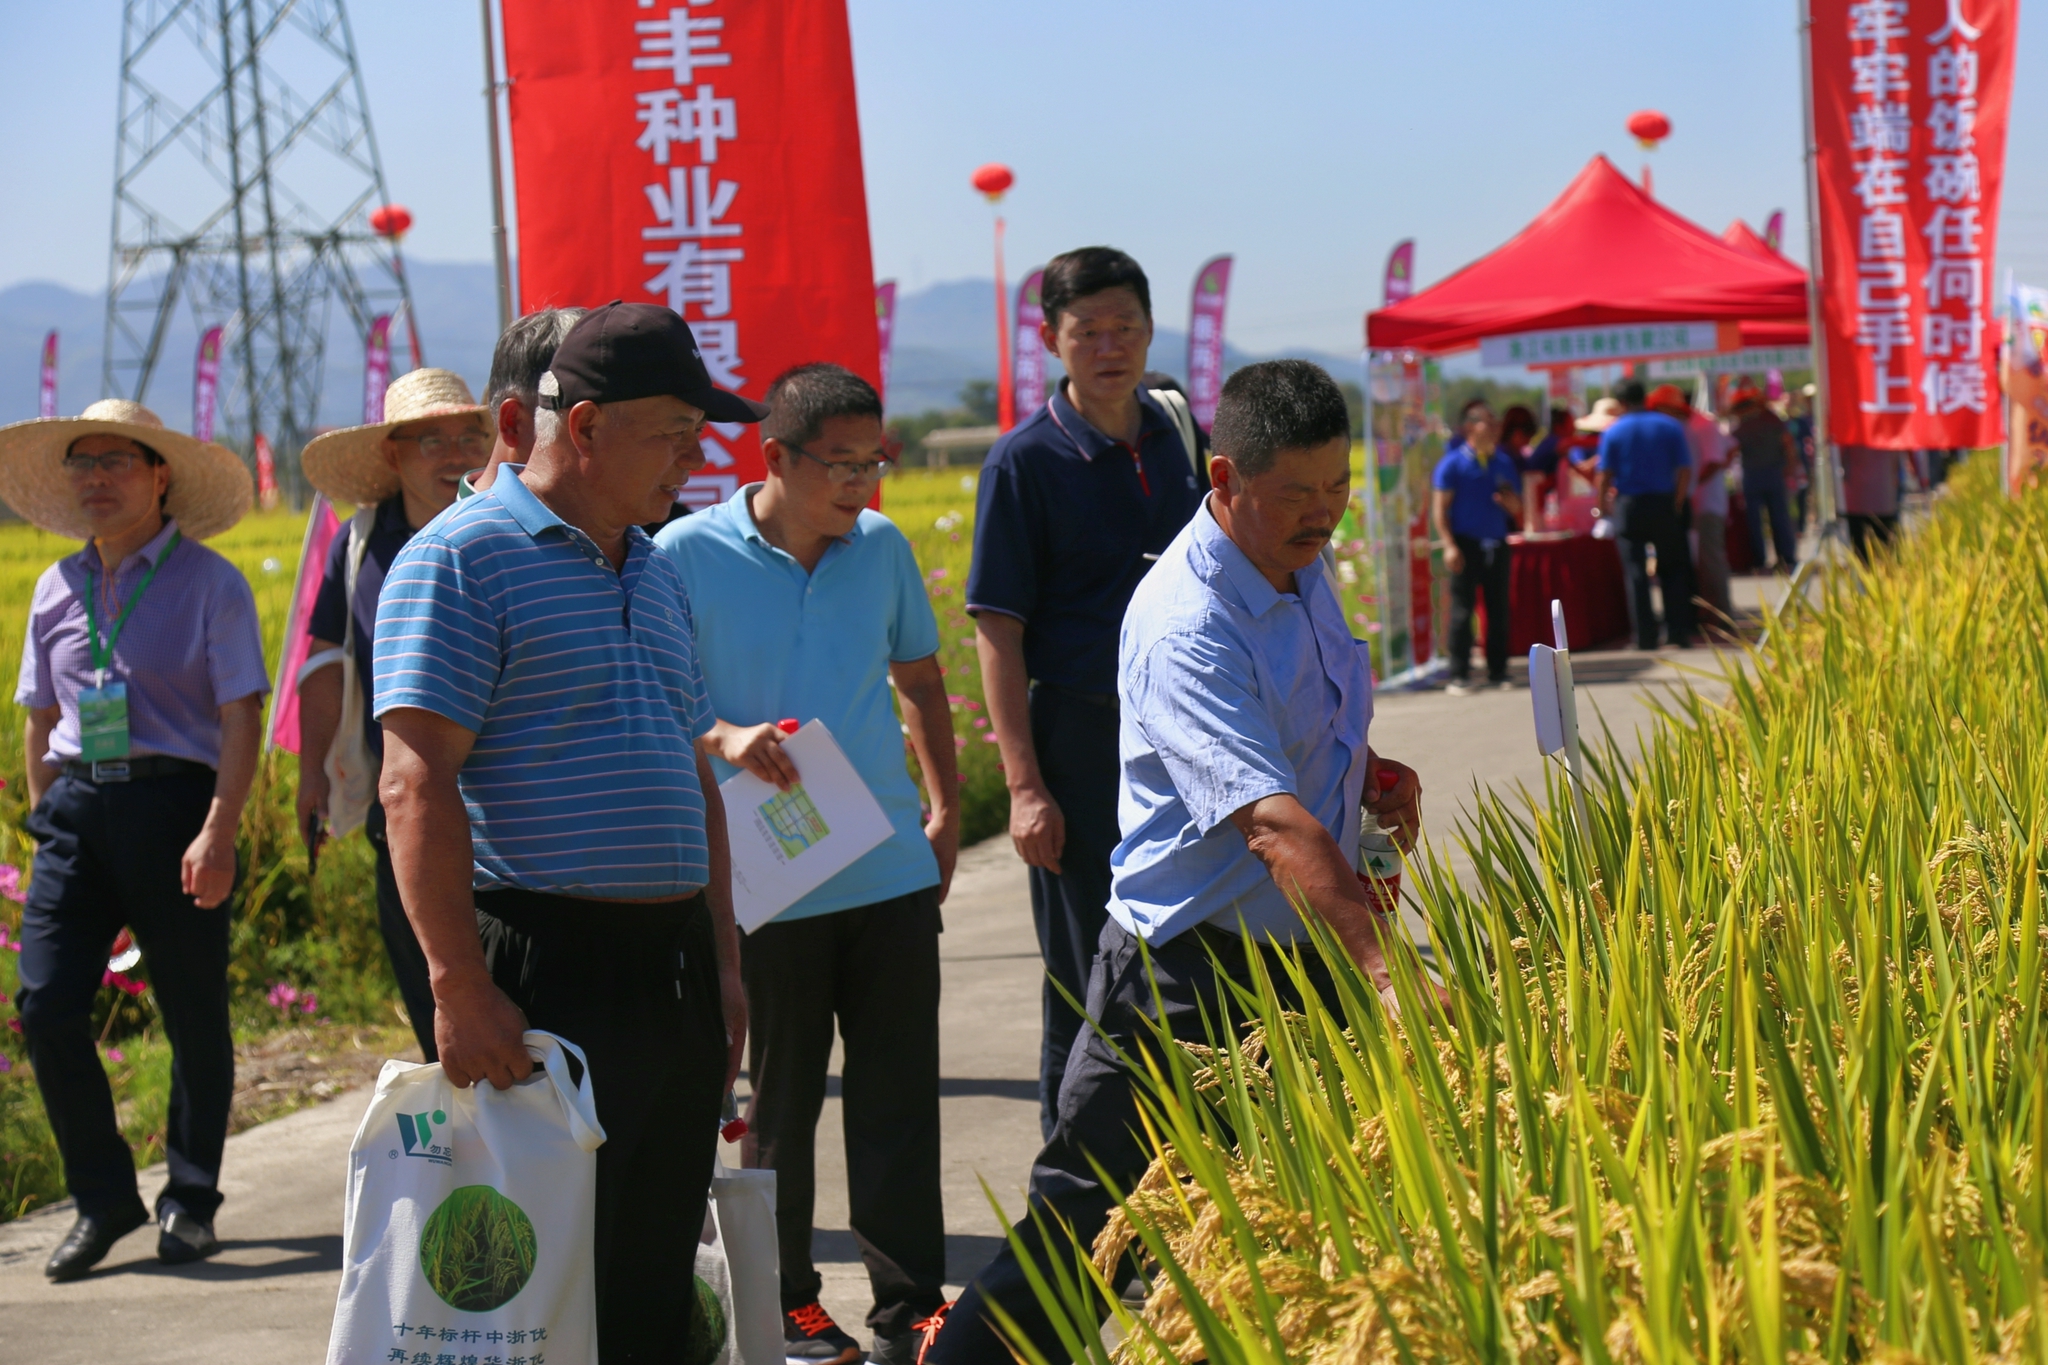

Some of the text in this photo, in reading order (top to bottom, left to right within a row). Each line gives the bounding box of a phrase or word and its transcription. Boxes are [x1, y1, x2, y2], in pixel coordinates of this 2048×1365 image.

[1847, 0, 1916, 414] 牢牢端在自己手上
[1921, 0, 1989, 416] 人的饭碗任何时候
[392, 1321, 549, 1345] 十年标杆中浙优
